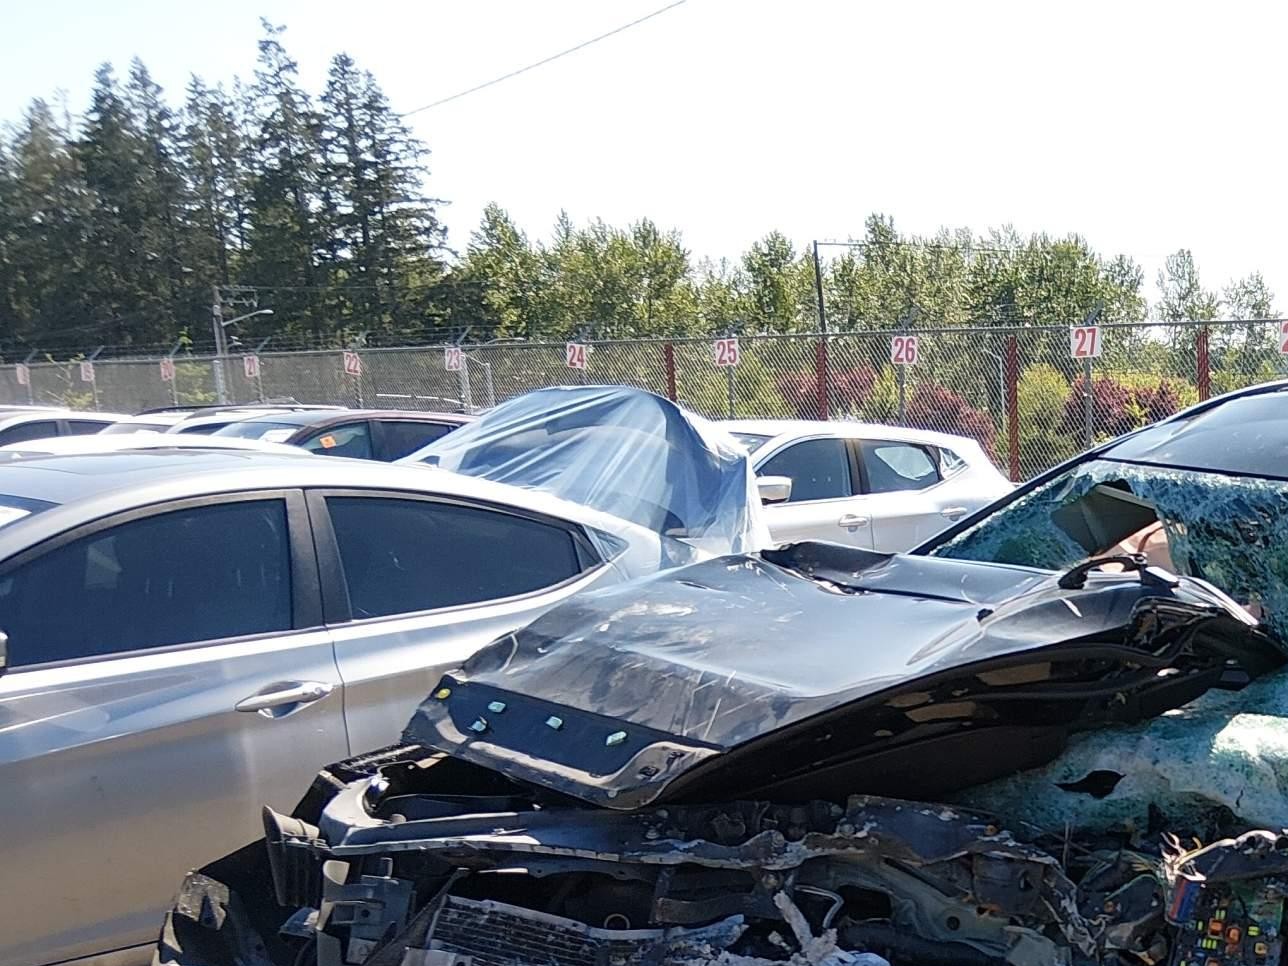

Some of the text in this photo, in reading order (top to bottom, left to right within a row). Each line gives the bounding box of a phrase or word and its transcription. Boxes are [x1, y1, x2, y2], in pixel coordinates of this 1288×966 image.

[716, 341, 738, 364] 25
[894, 338, 916, 364] 26
[1074, 328, 1097, 357] 27
[345, 354, 358, 373] 22
[447, 350, 460, 370] 23
[568, 346, 585, 368] 24
